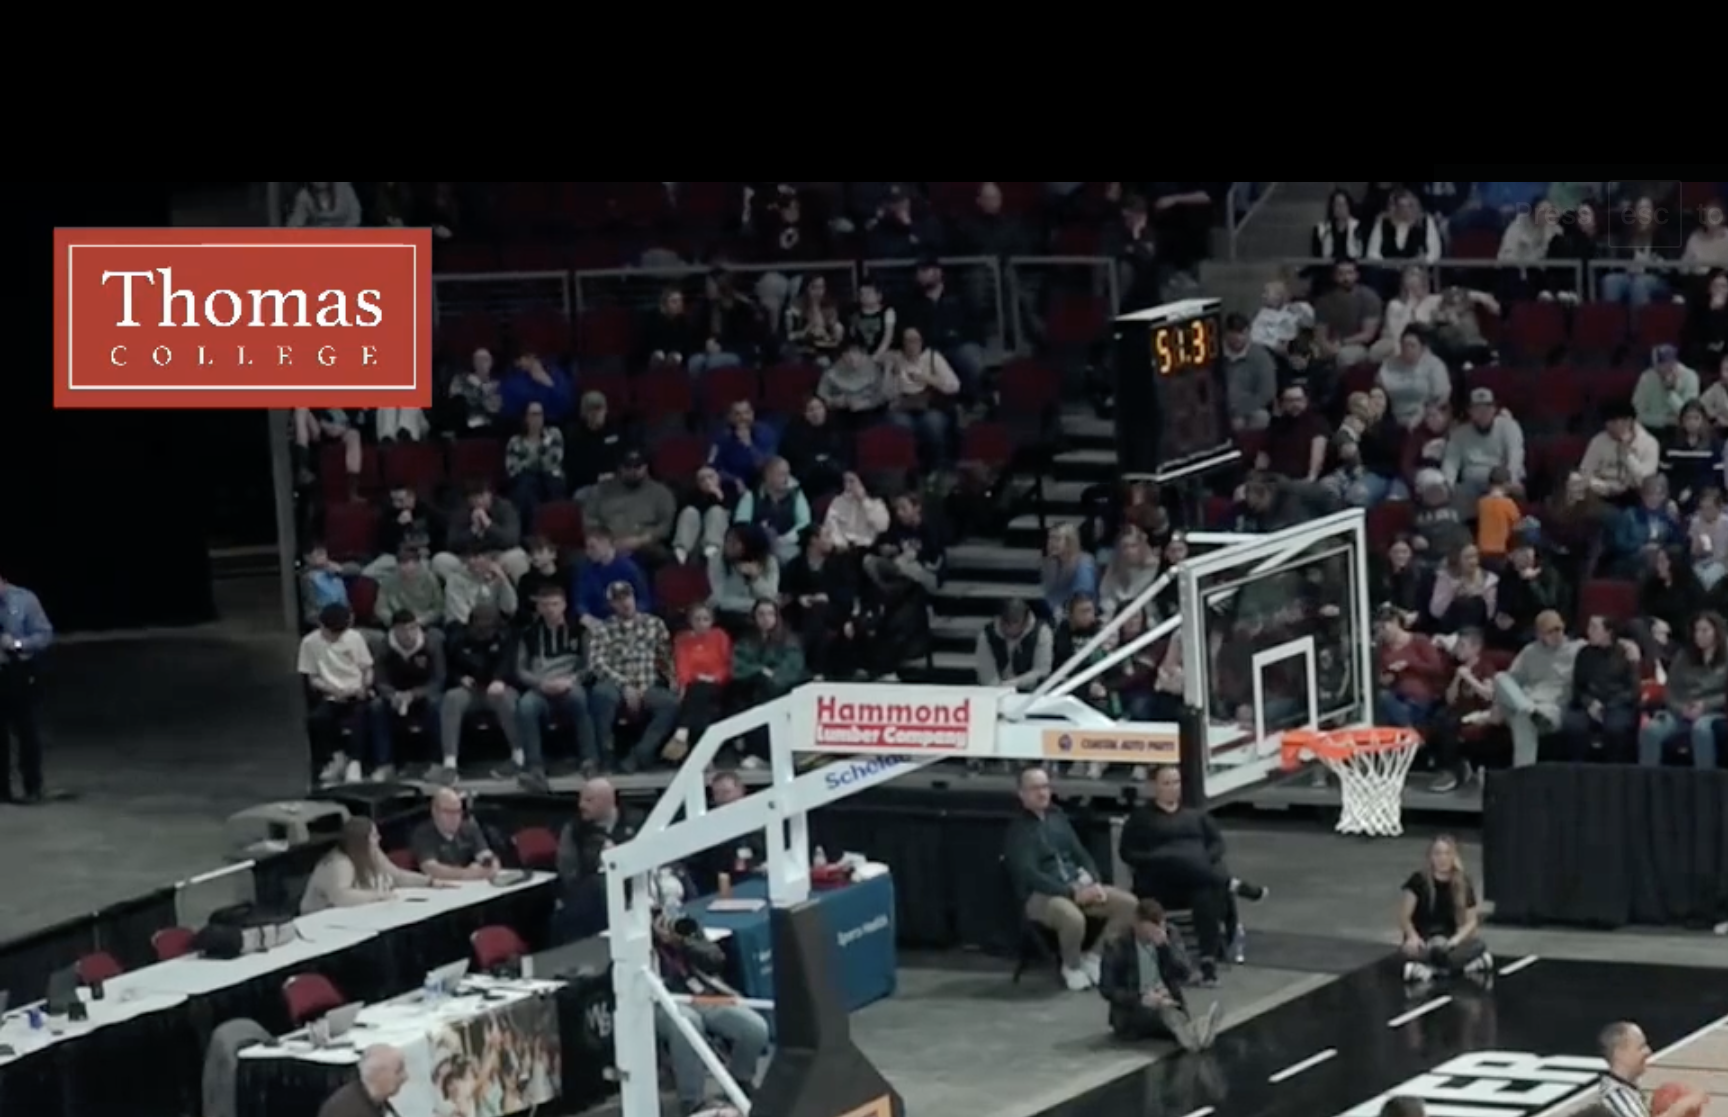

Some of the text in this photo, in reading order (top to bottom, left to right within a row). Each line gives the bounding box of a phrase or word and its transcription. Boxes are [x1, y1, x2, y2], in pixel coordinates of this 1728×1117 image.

[1156, 320, 1205, 373] 51.3
[817, 696, 970, 723] Hammond
[816, 723, 968, 750] Lumber Company
